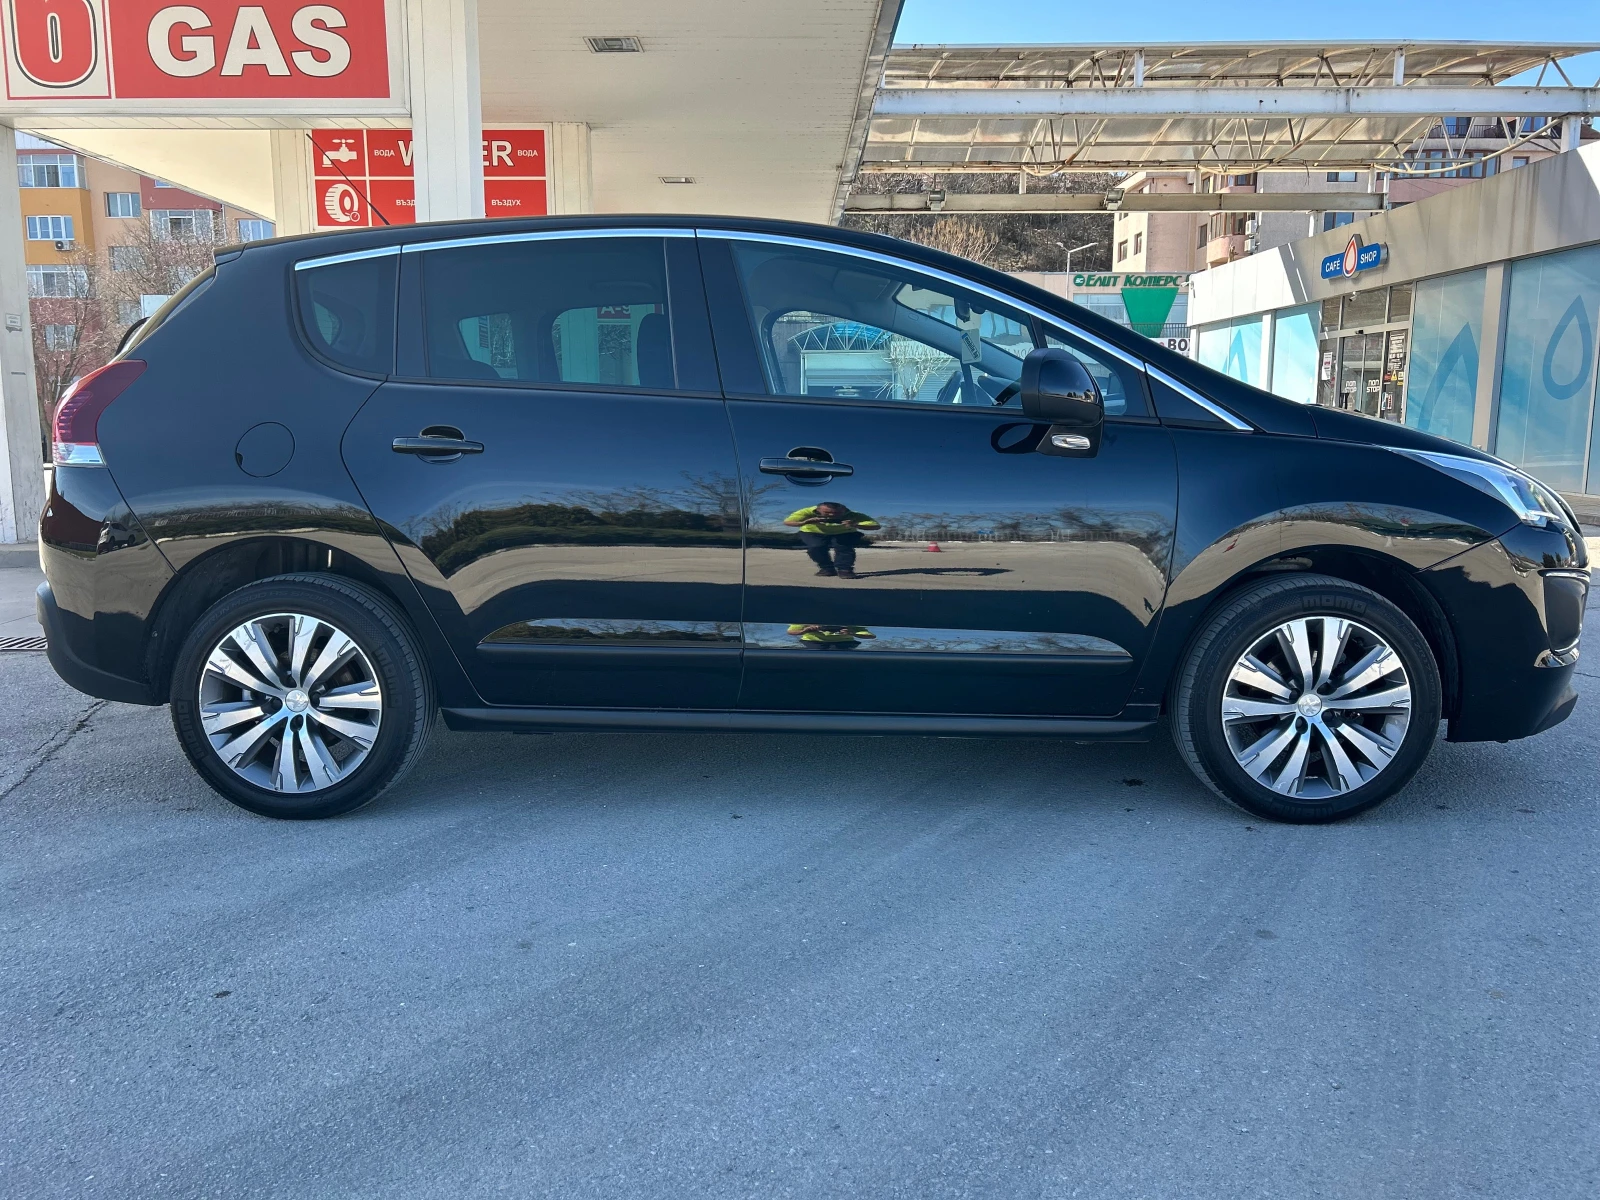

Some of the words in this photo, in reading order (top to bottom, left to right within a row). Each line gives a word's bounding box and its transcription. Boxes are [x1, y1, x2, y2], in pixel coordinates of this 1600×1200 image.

[147, 4, 351, 78] GAS
[374, 149, 395, 157] ВОДА
[517, 149, 538, 157] ВОДА
[396, 199, 416, 207] ВЪЗД
[491, 199, 521, 207] ВЪЗДУХ
[1325, 257, 1341, 272] CAFÉ
[1360, 250, 1377, 264] SHOP
